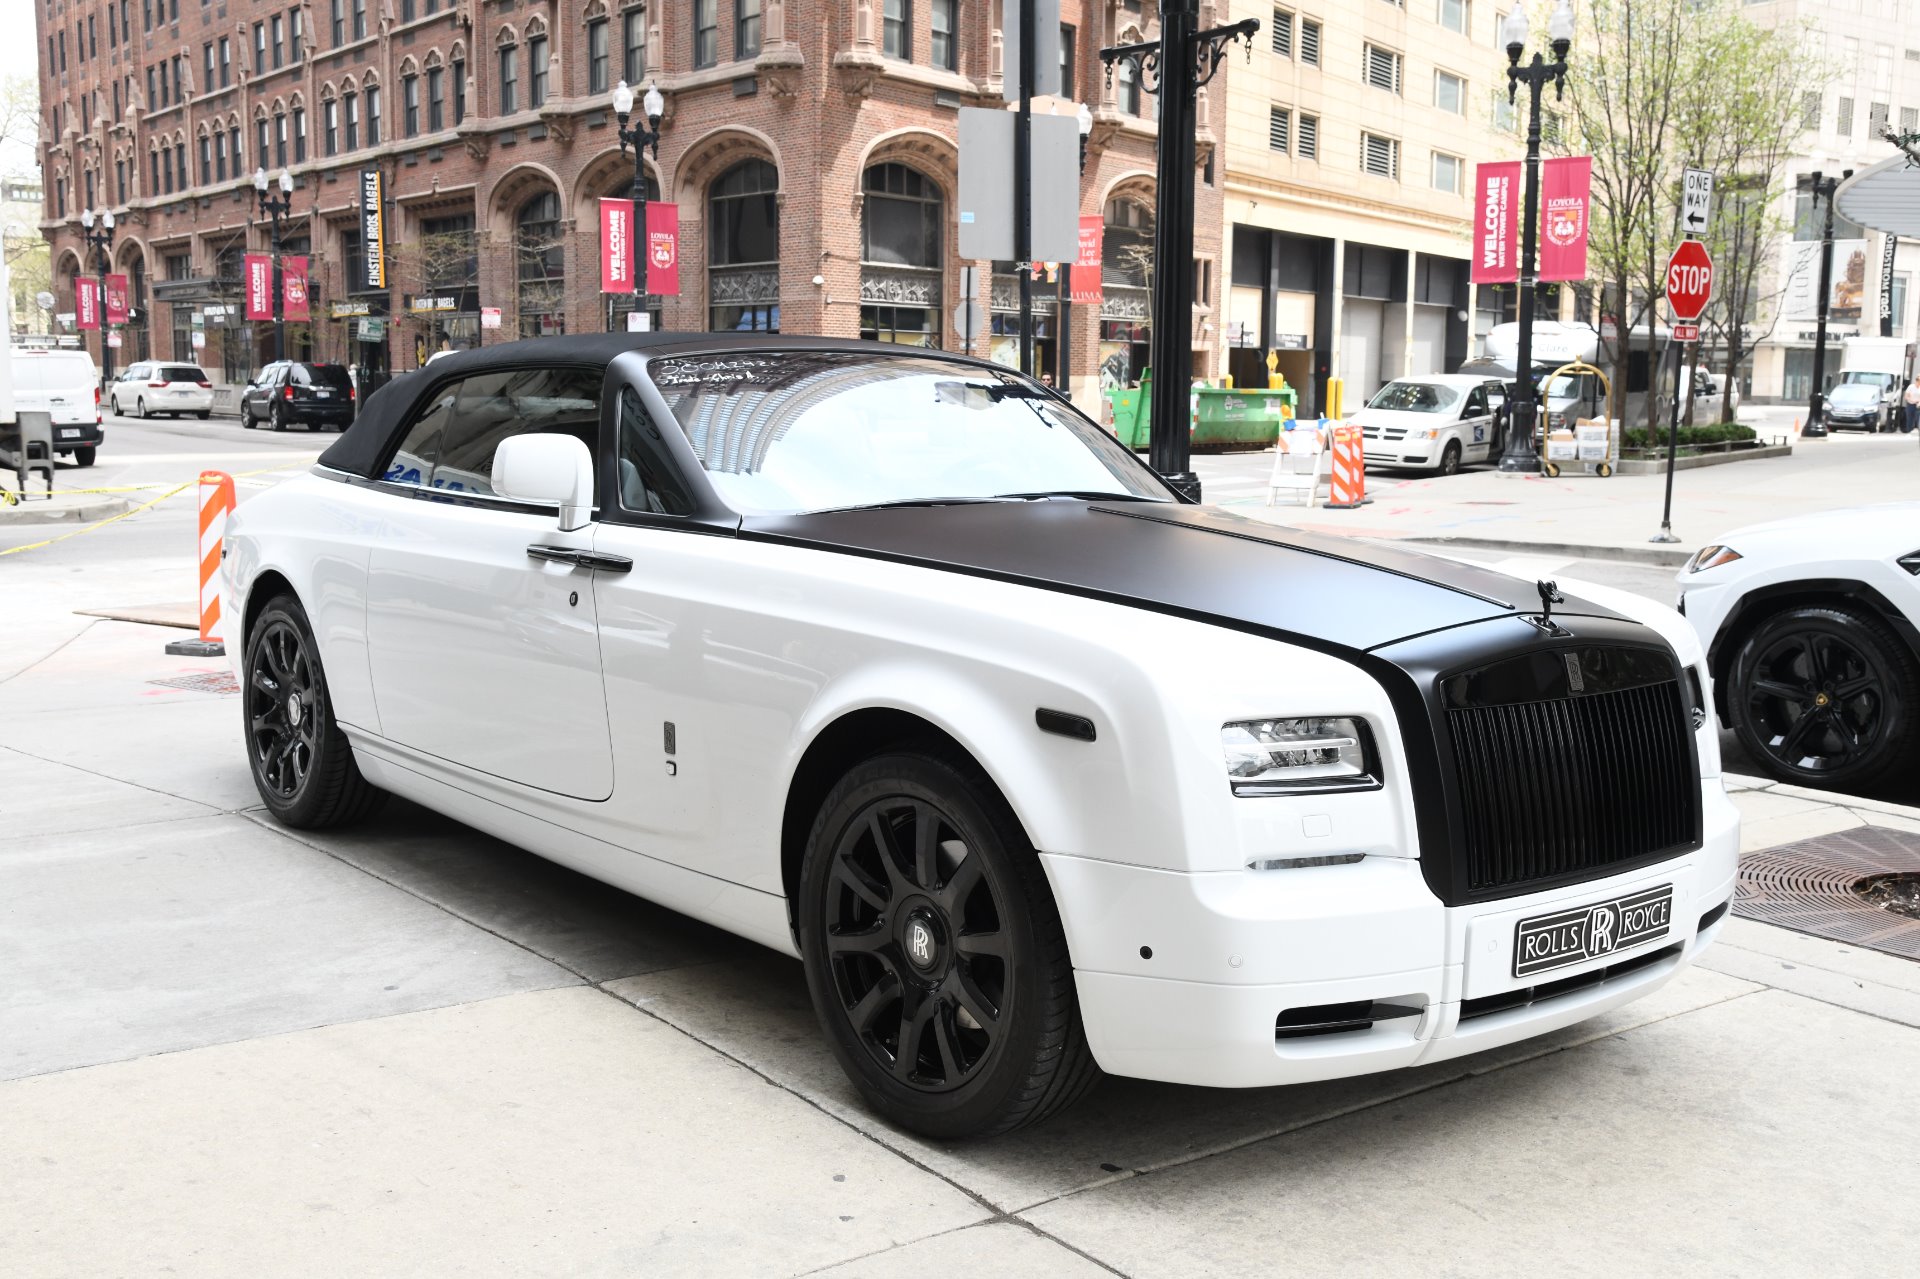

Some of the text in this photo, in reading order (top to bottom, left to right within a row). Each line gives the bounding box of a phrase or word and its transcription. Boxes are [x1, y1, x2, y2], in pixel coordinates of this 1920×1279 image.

[1688, 175, 1709, 191] ONE
[1548, 198, 1583, 207] LOYOLA
[1687, 193, 1708, 209] WAY
[365, 172, 380, 286] EINSTEIN BROS. BAGELS
[650, 232, 674, 240] LOYOLA
[1483, 176, 1501, 269] WELCOME
[1498, 176, 1509, 268] WATER TOWER CAMPUS
[609, 210, 621, 281] WELCOME
[252, 263, 261, 312] WELCOME
[1669, 264, 1710, 296] STOP
[1880, 234, 1894, 319] ORDSTROM rack
[1070, 291, 1101, 301] LUMA
[1675, 328, 1685, 338] ALL
[1685, 328, 1697, 338] WAY
[913, 925, 929, 960] RR
[1525, 926, 1579, 960] ROLLS
[1623, 901, 1668, 934] ROYCE
